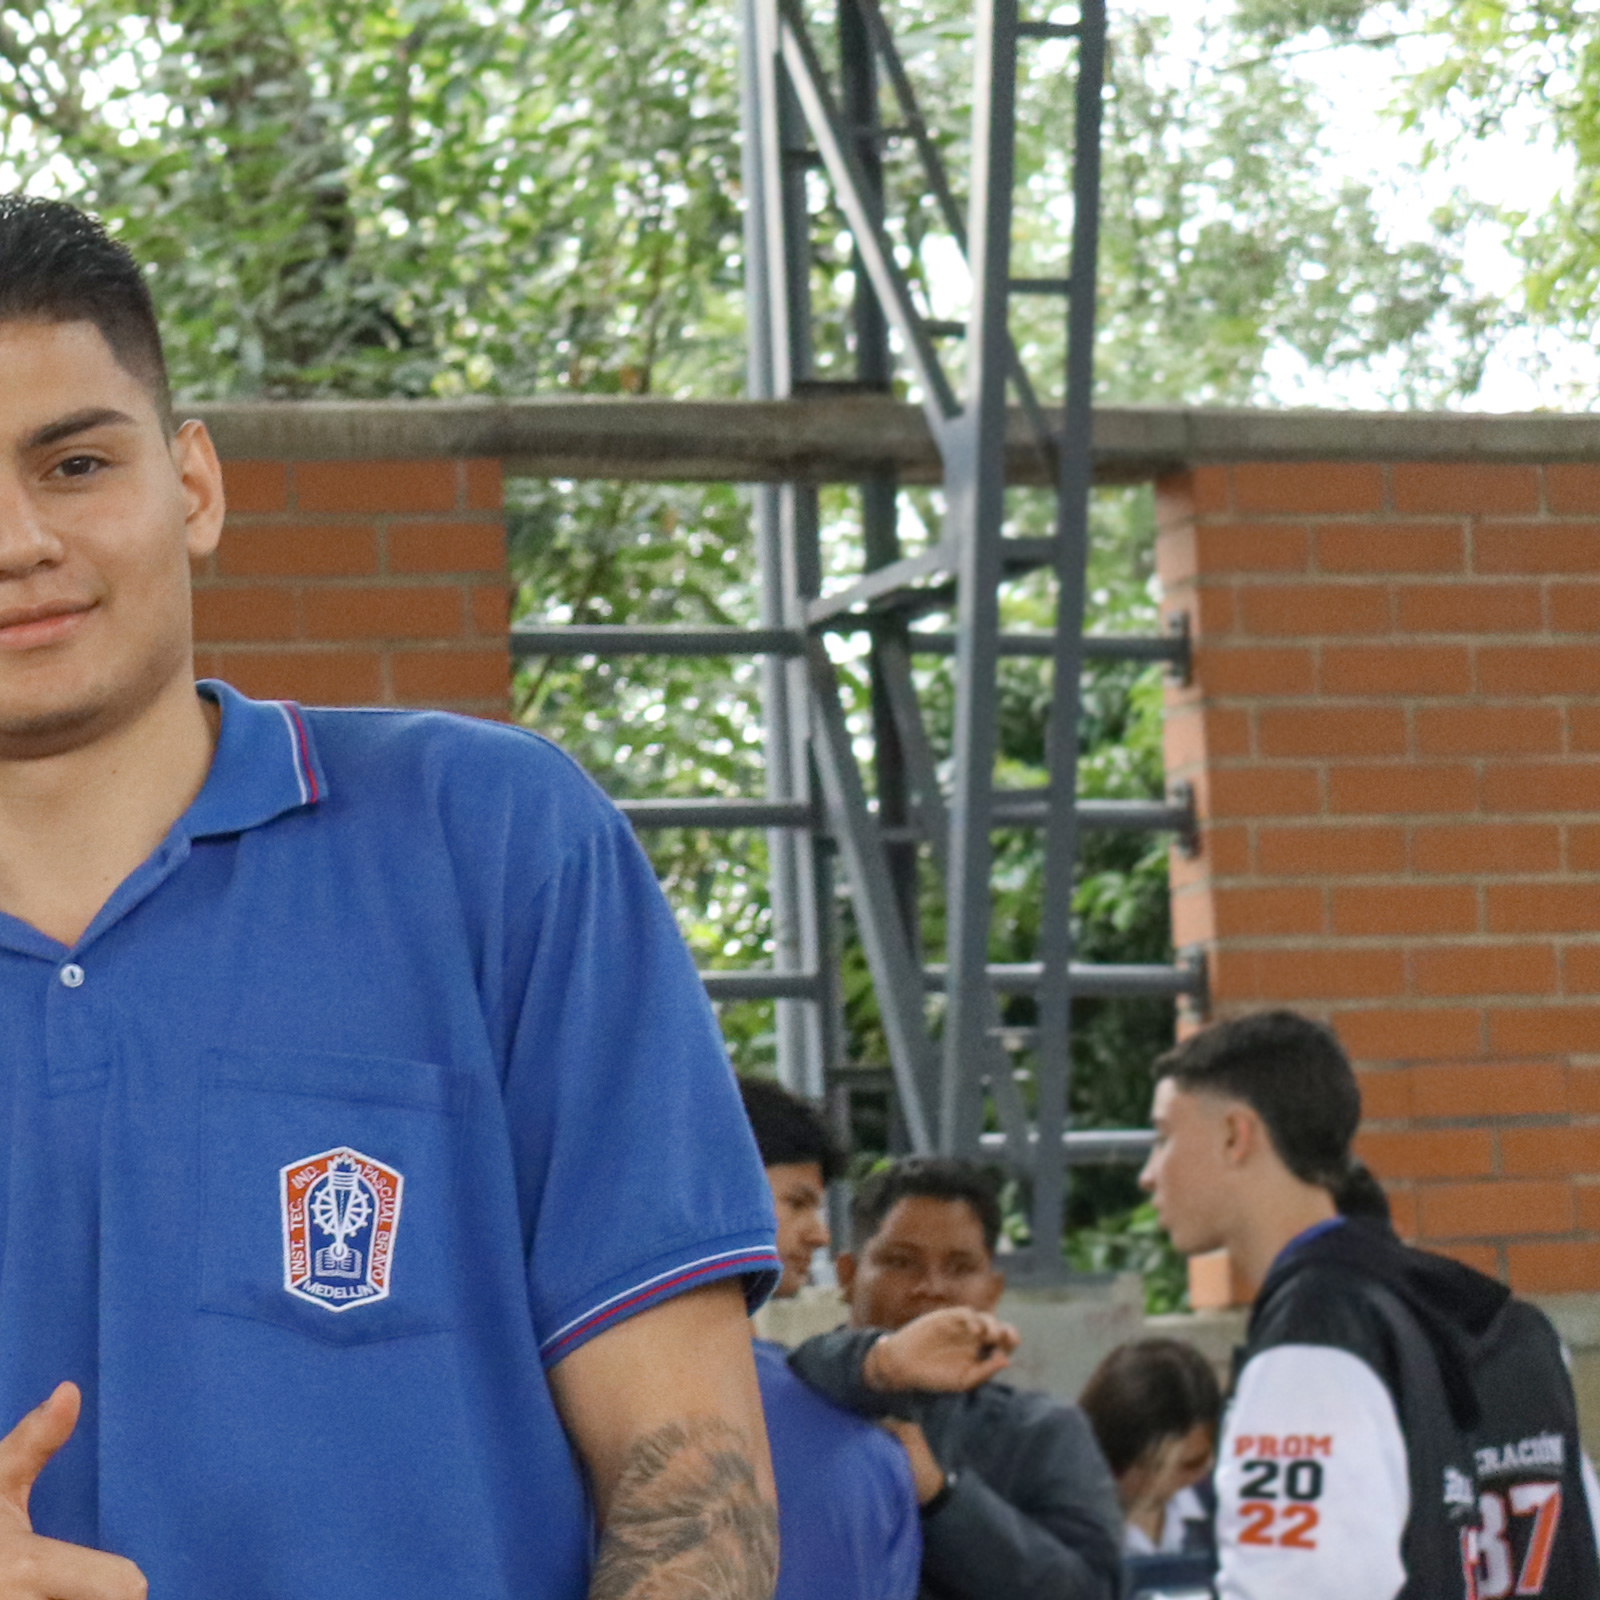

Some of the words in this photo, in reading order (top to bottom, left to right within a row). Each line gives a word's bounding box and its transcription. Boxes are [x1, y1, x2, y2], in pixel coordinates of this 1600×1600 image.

[1233, 1434, 1333, 1458] PROM
[1238, 1459, 1324, 1501] 20
[1238, 1502, 1320, 1551] 22
